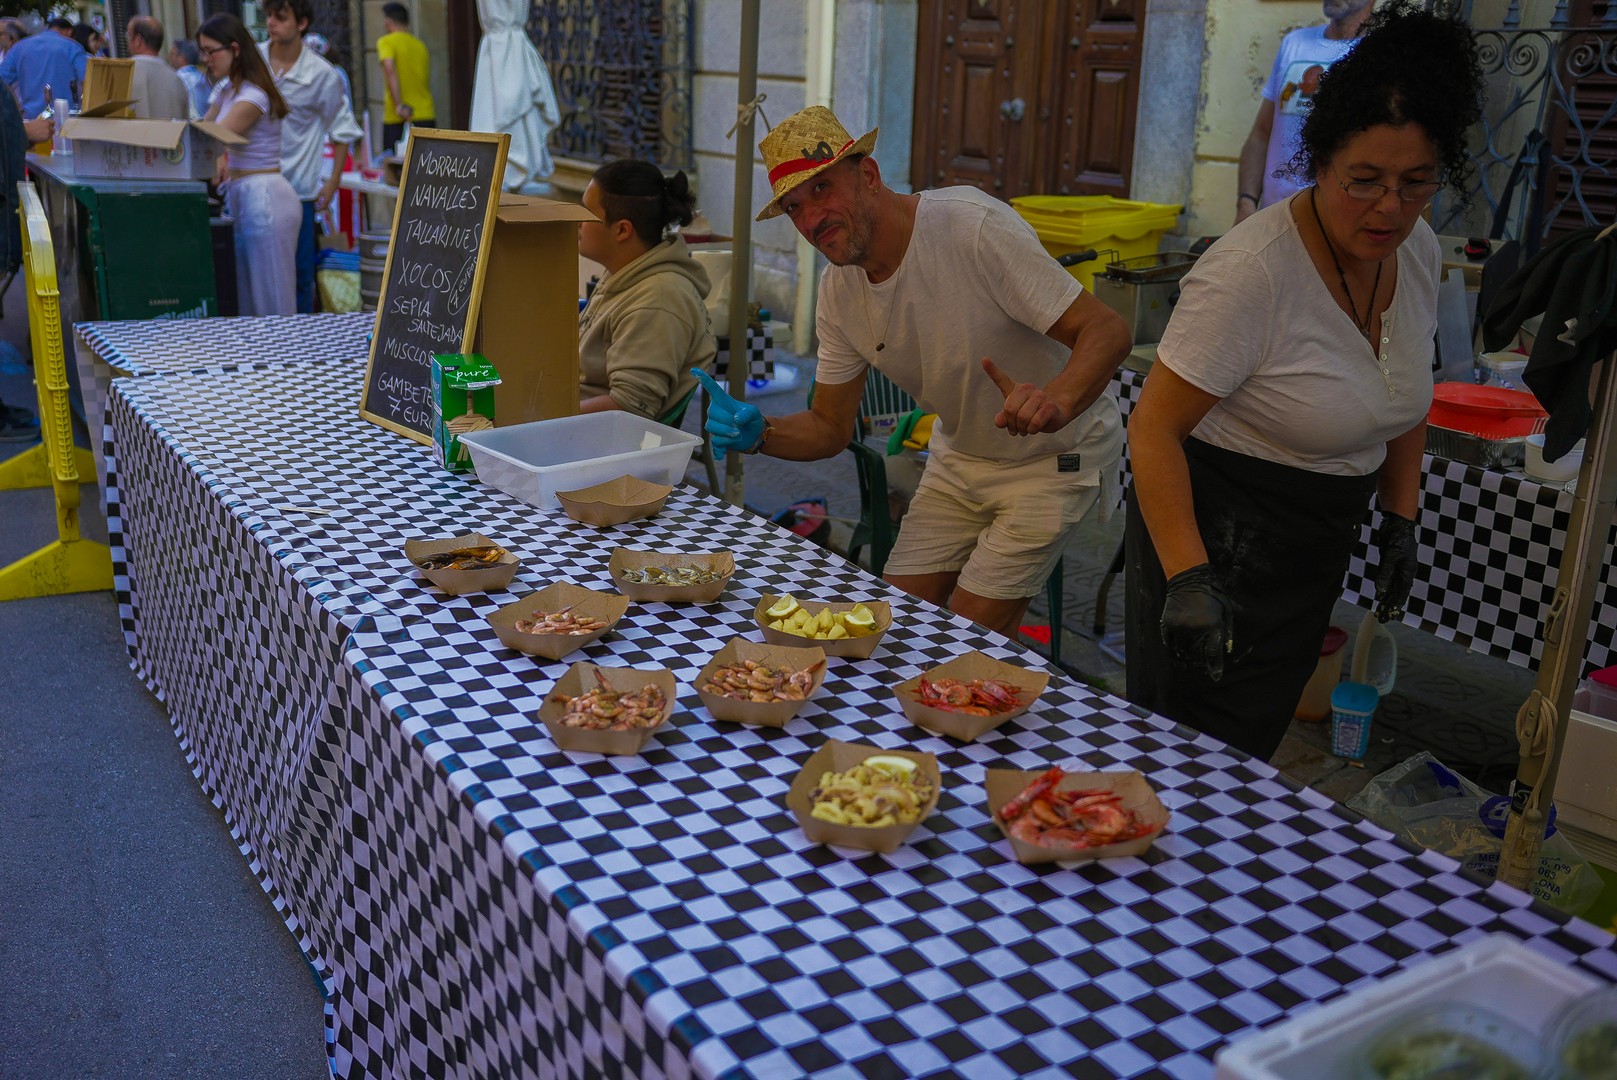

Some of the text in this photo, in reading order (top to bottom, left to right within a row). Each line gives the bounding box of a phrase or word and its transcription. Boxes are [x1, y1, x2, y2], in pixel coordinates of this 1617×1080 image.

[416, 151, 478, 178] MORRALLA
[410, 184, 480, 211] NAVALLES
[406, 219, 480, 252] TALLARINES
[398, 257, 452, 293] XOCOS
[390, 296, 432, 317] SEPIA
[407, 318, 463, 346] SALTEJADA
[383, 337, 435, 368] MUSCLOS
[456, 369, 489, 382] pure
[388, 395, 401, 416] 7
